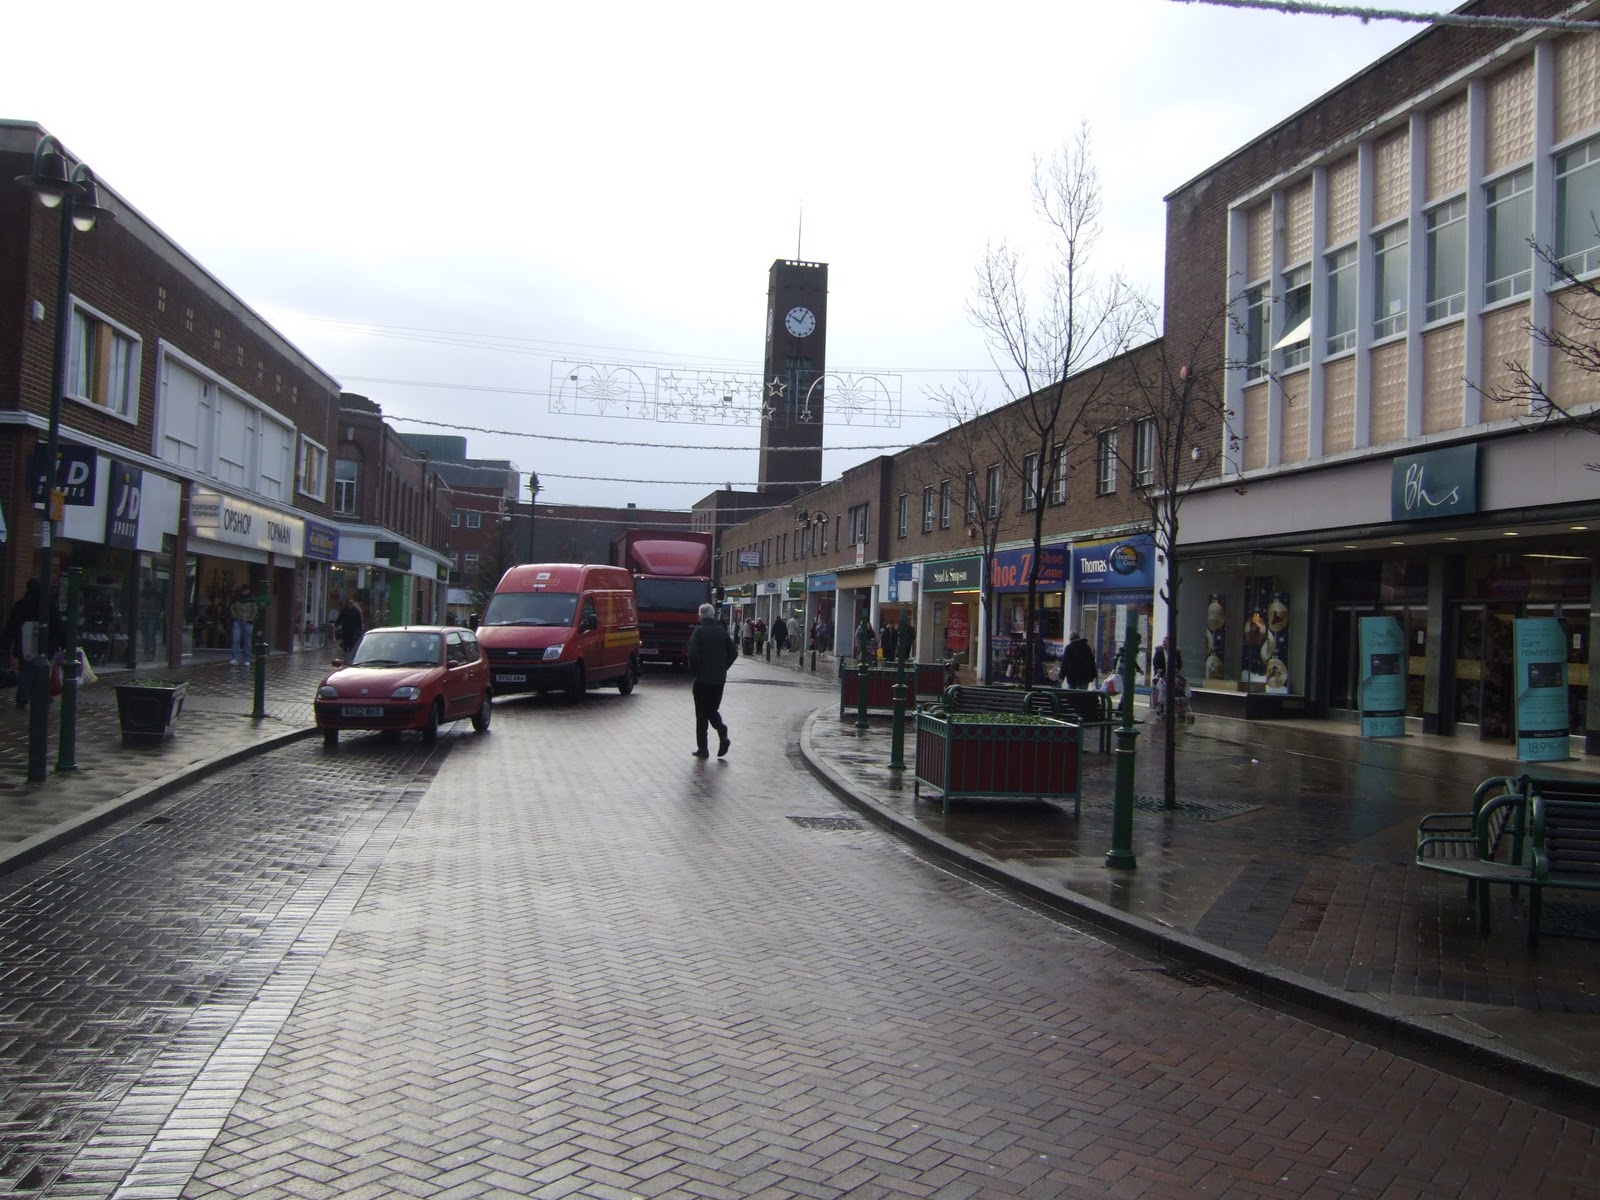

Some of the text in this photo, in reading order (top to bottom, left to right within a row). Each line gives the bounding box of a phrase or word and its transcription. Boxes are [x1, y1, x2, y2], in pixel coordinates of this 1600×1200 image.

[1404, 462, 1460, 511] Bhs
[113, 521, 137, 538] SPORTS
[223, 508, 253, 535] OPSHOP
[267, 521, 291, 545] TOPMAN
[991, 558, 1017, 588] hoe
[1037, 564, 1064, 579] Zone
[1080, 557, 1108, 574] Thomas
[948, 629, 967, 638] SALE
[1521, 638, 1541, 648] Earn
